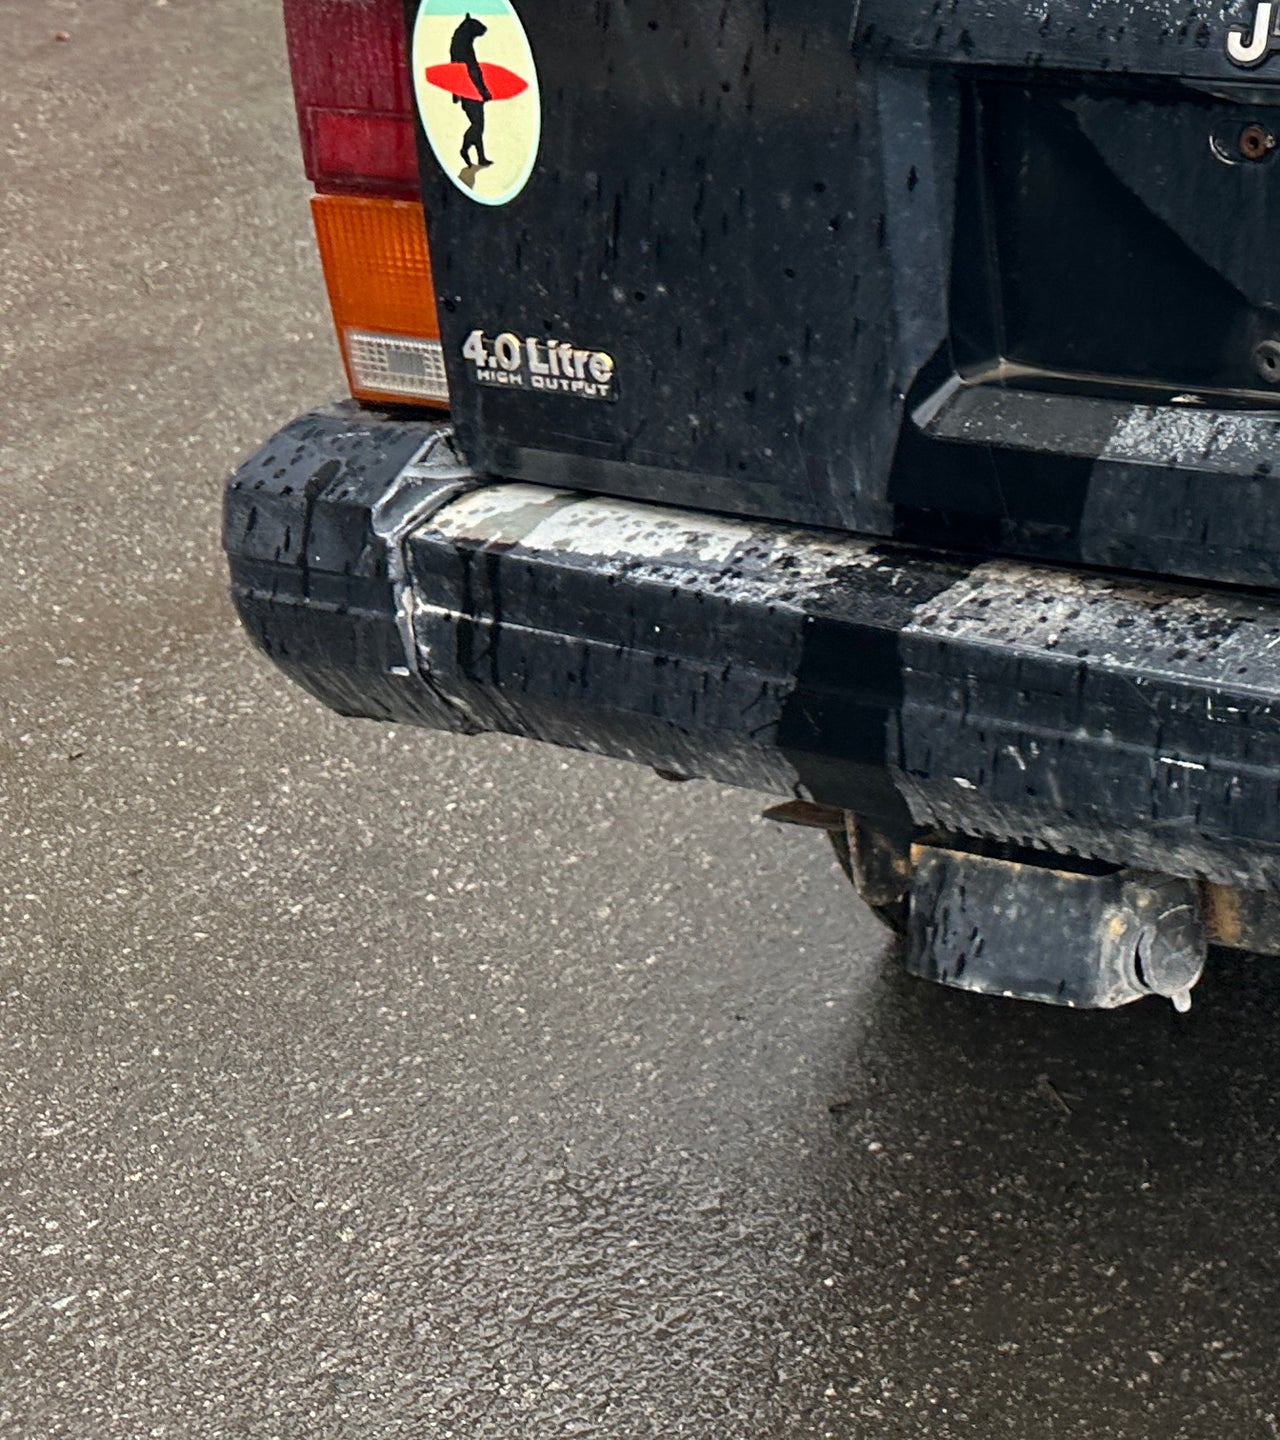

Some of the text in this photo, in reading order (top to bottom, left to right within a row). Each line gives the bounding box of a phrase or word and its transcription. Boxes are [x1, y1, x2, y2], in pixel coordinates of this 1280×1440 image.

[462, 329, 615, 383] 4.0 Litre
[477, 369, 611, 396] HIGH OUTPUT
